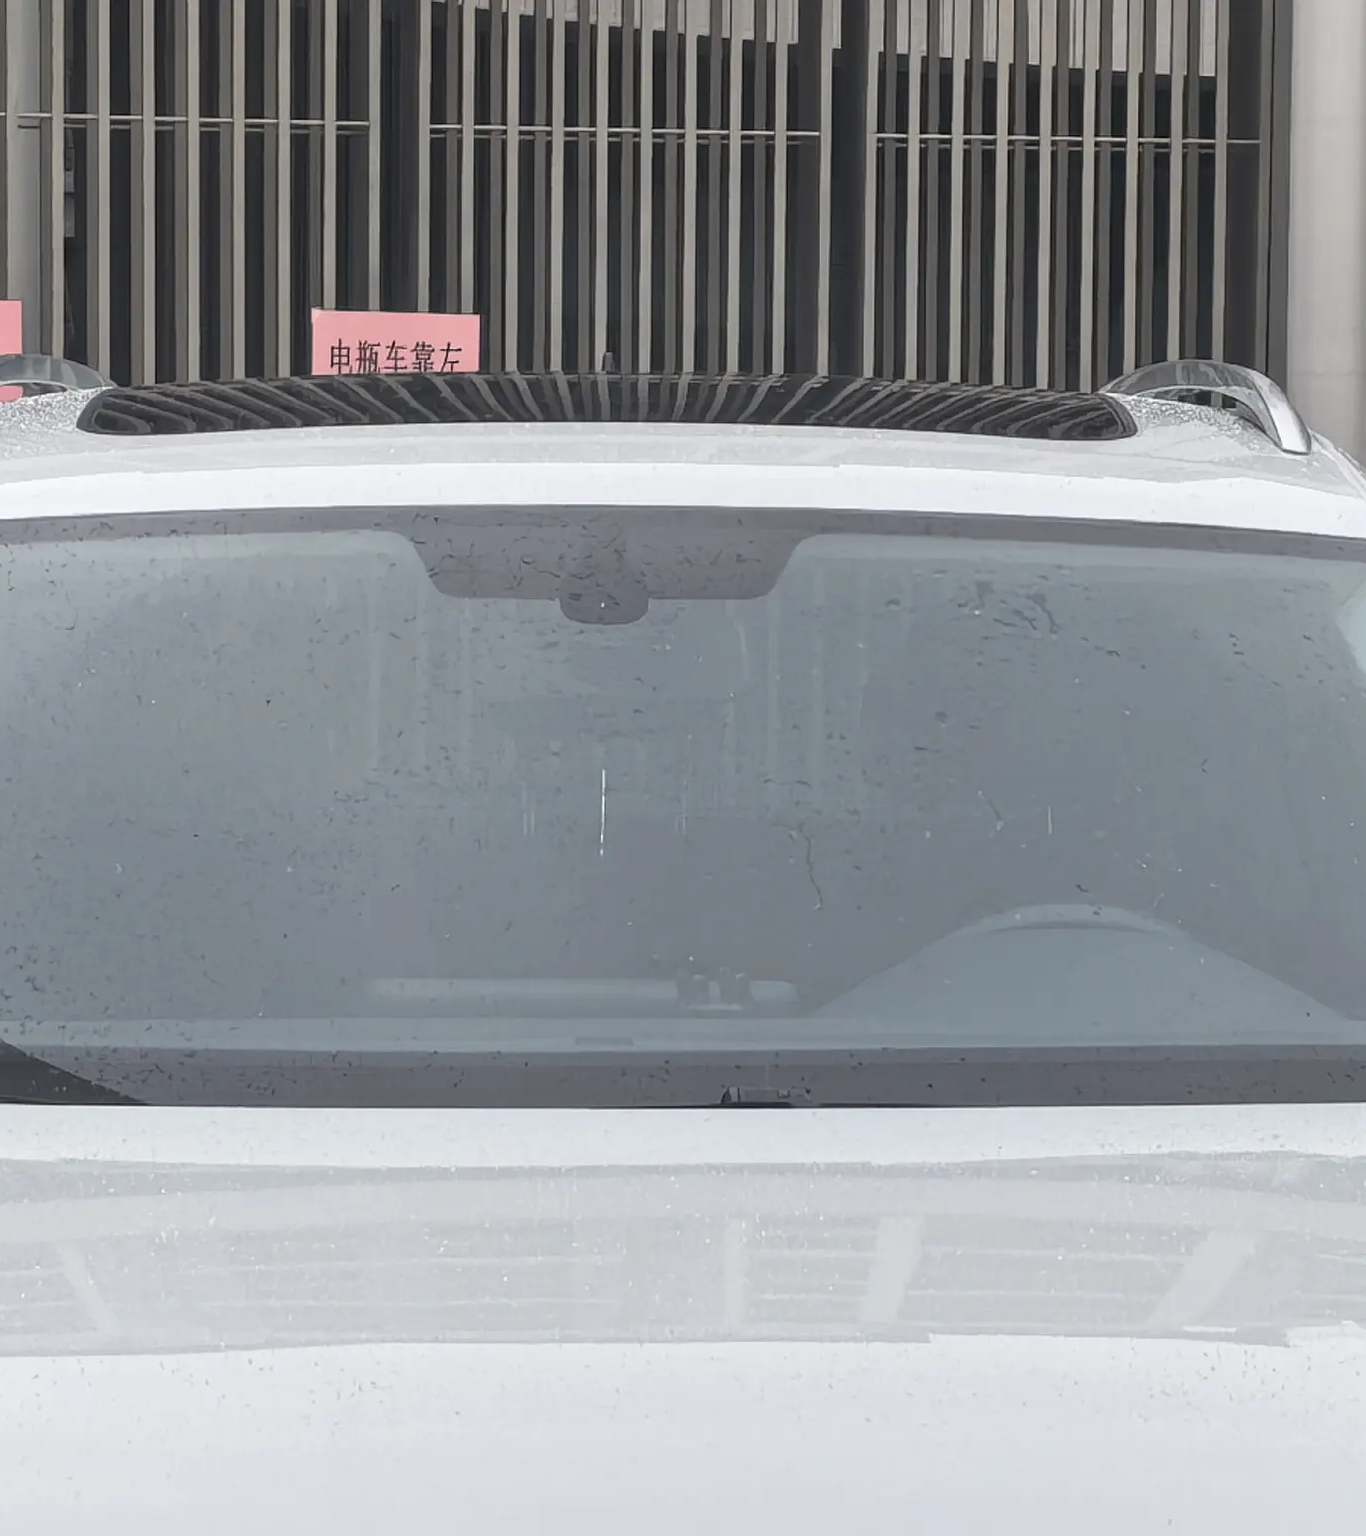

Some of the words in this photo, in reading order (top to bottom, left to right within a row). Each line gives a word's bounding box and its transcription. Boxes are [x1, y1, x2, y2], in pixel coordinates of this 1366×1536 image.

[330, 338, 463, 374] 电瓶车靠左
